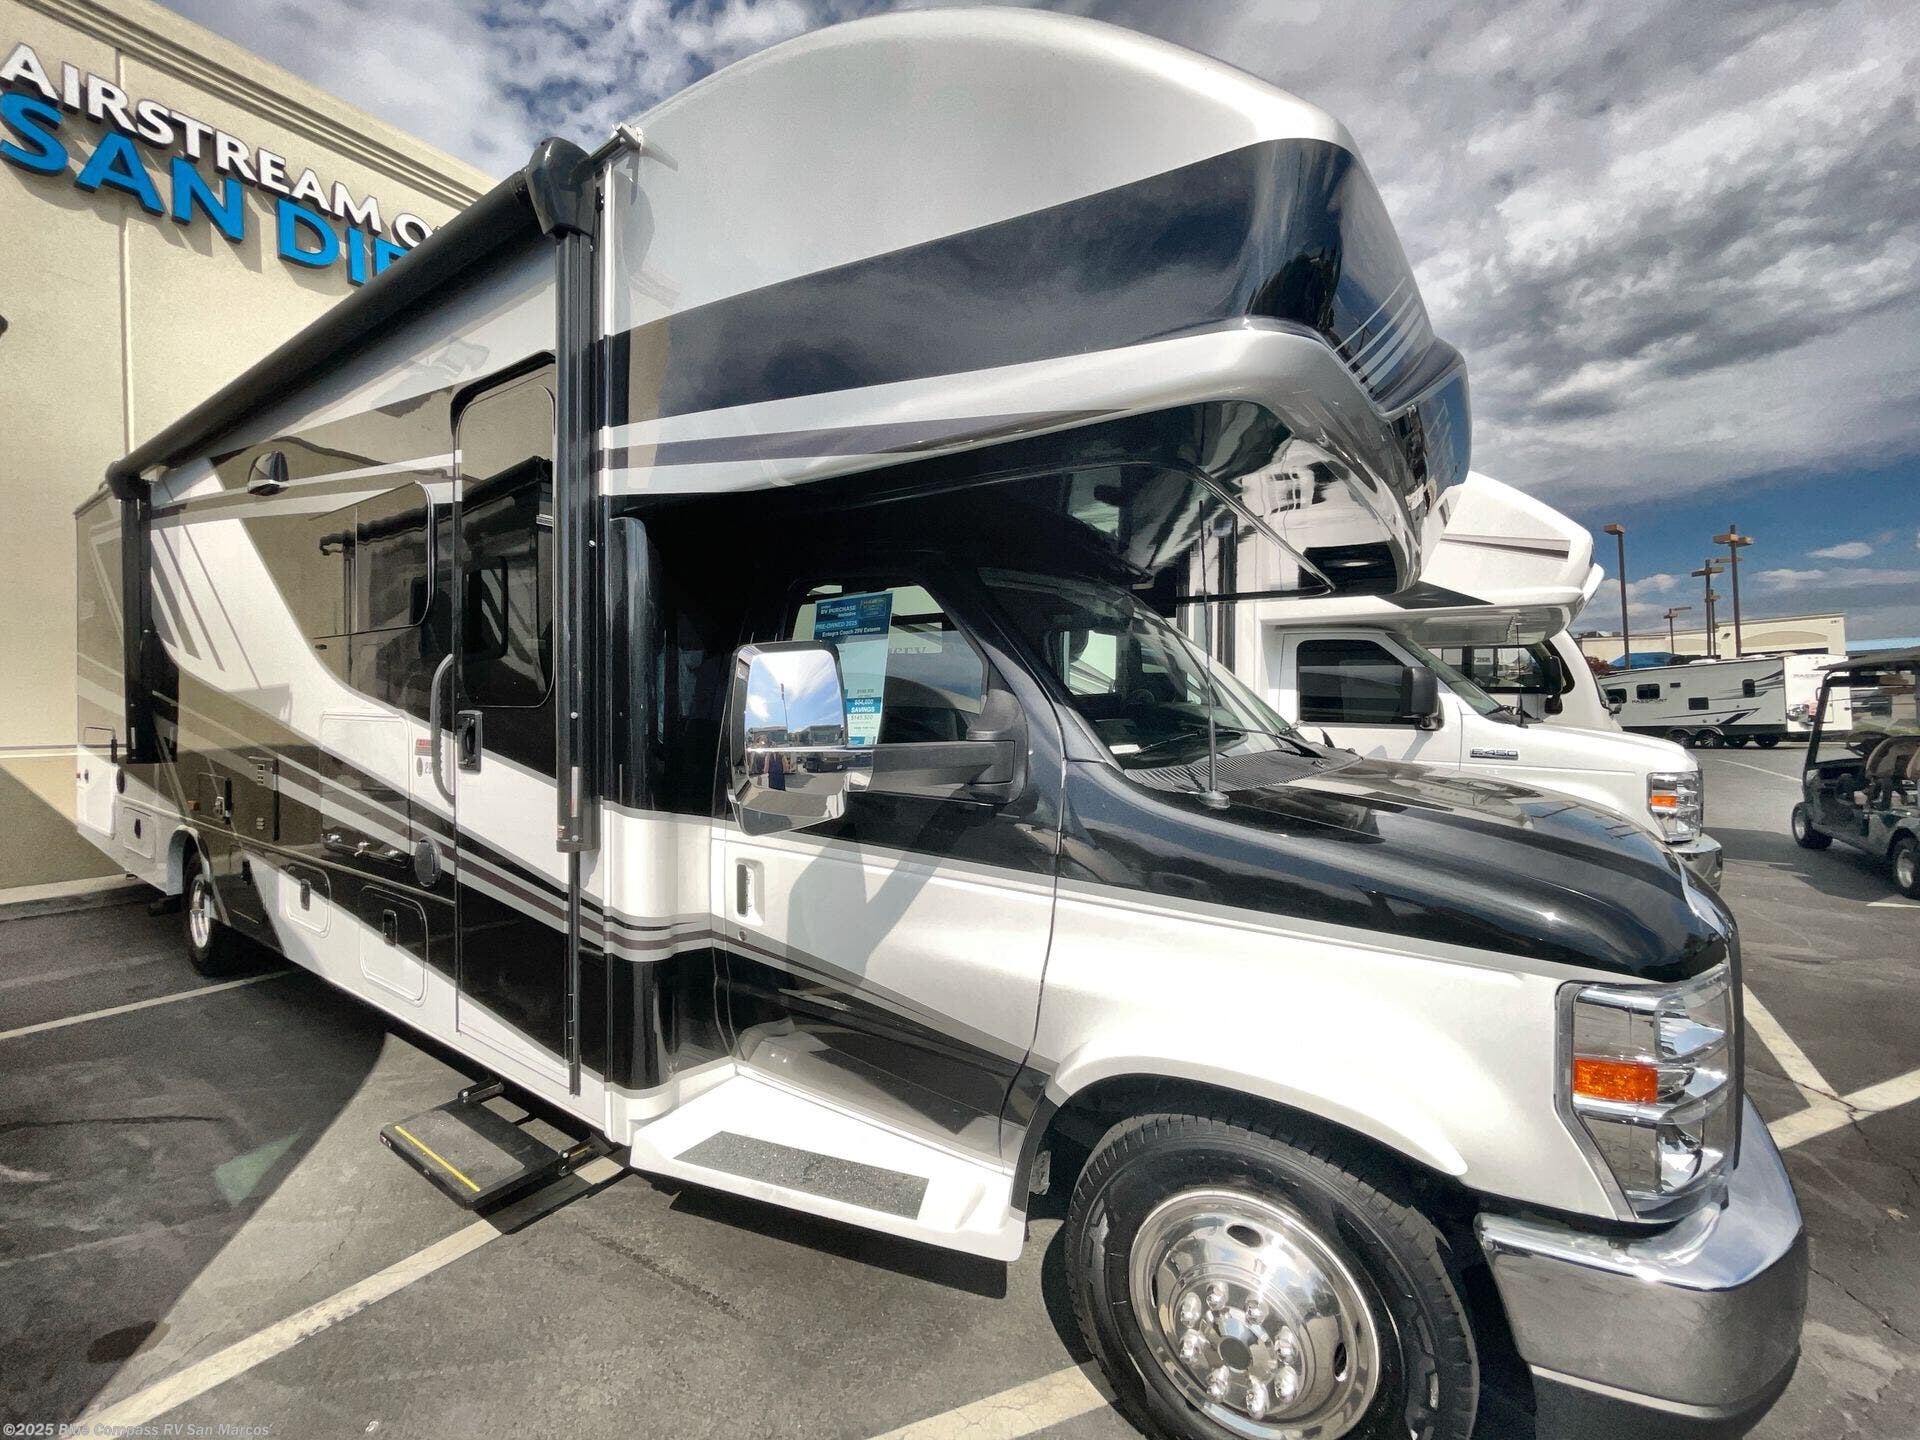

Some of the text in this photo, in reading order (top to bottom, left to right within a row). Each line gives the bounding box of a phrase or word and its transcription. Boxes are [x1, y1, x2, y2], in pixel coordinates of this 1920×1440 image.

[0, 41, 439, 251] AIRSTREAM O
[0, 91, 245, 243] SAN
[828, 605, 857, 614] PURCHASE
[816, 621, 845, 629] PRE-OWNED
[1470, 748, 1518, 759] E-450
